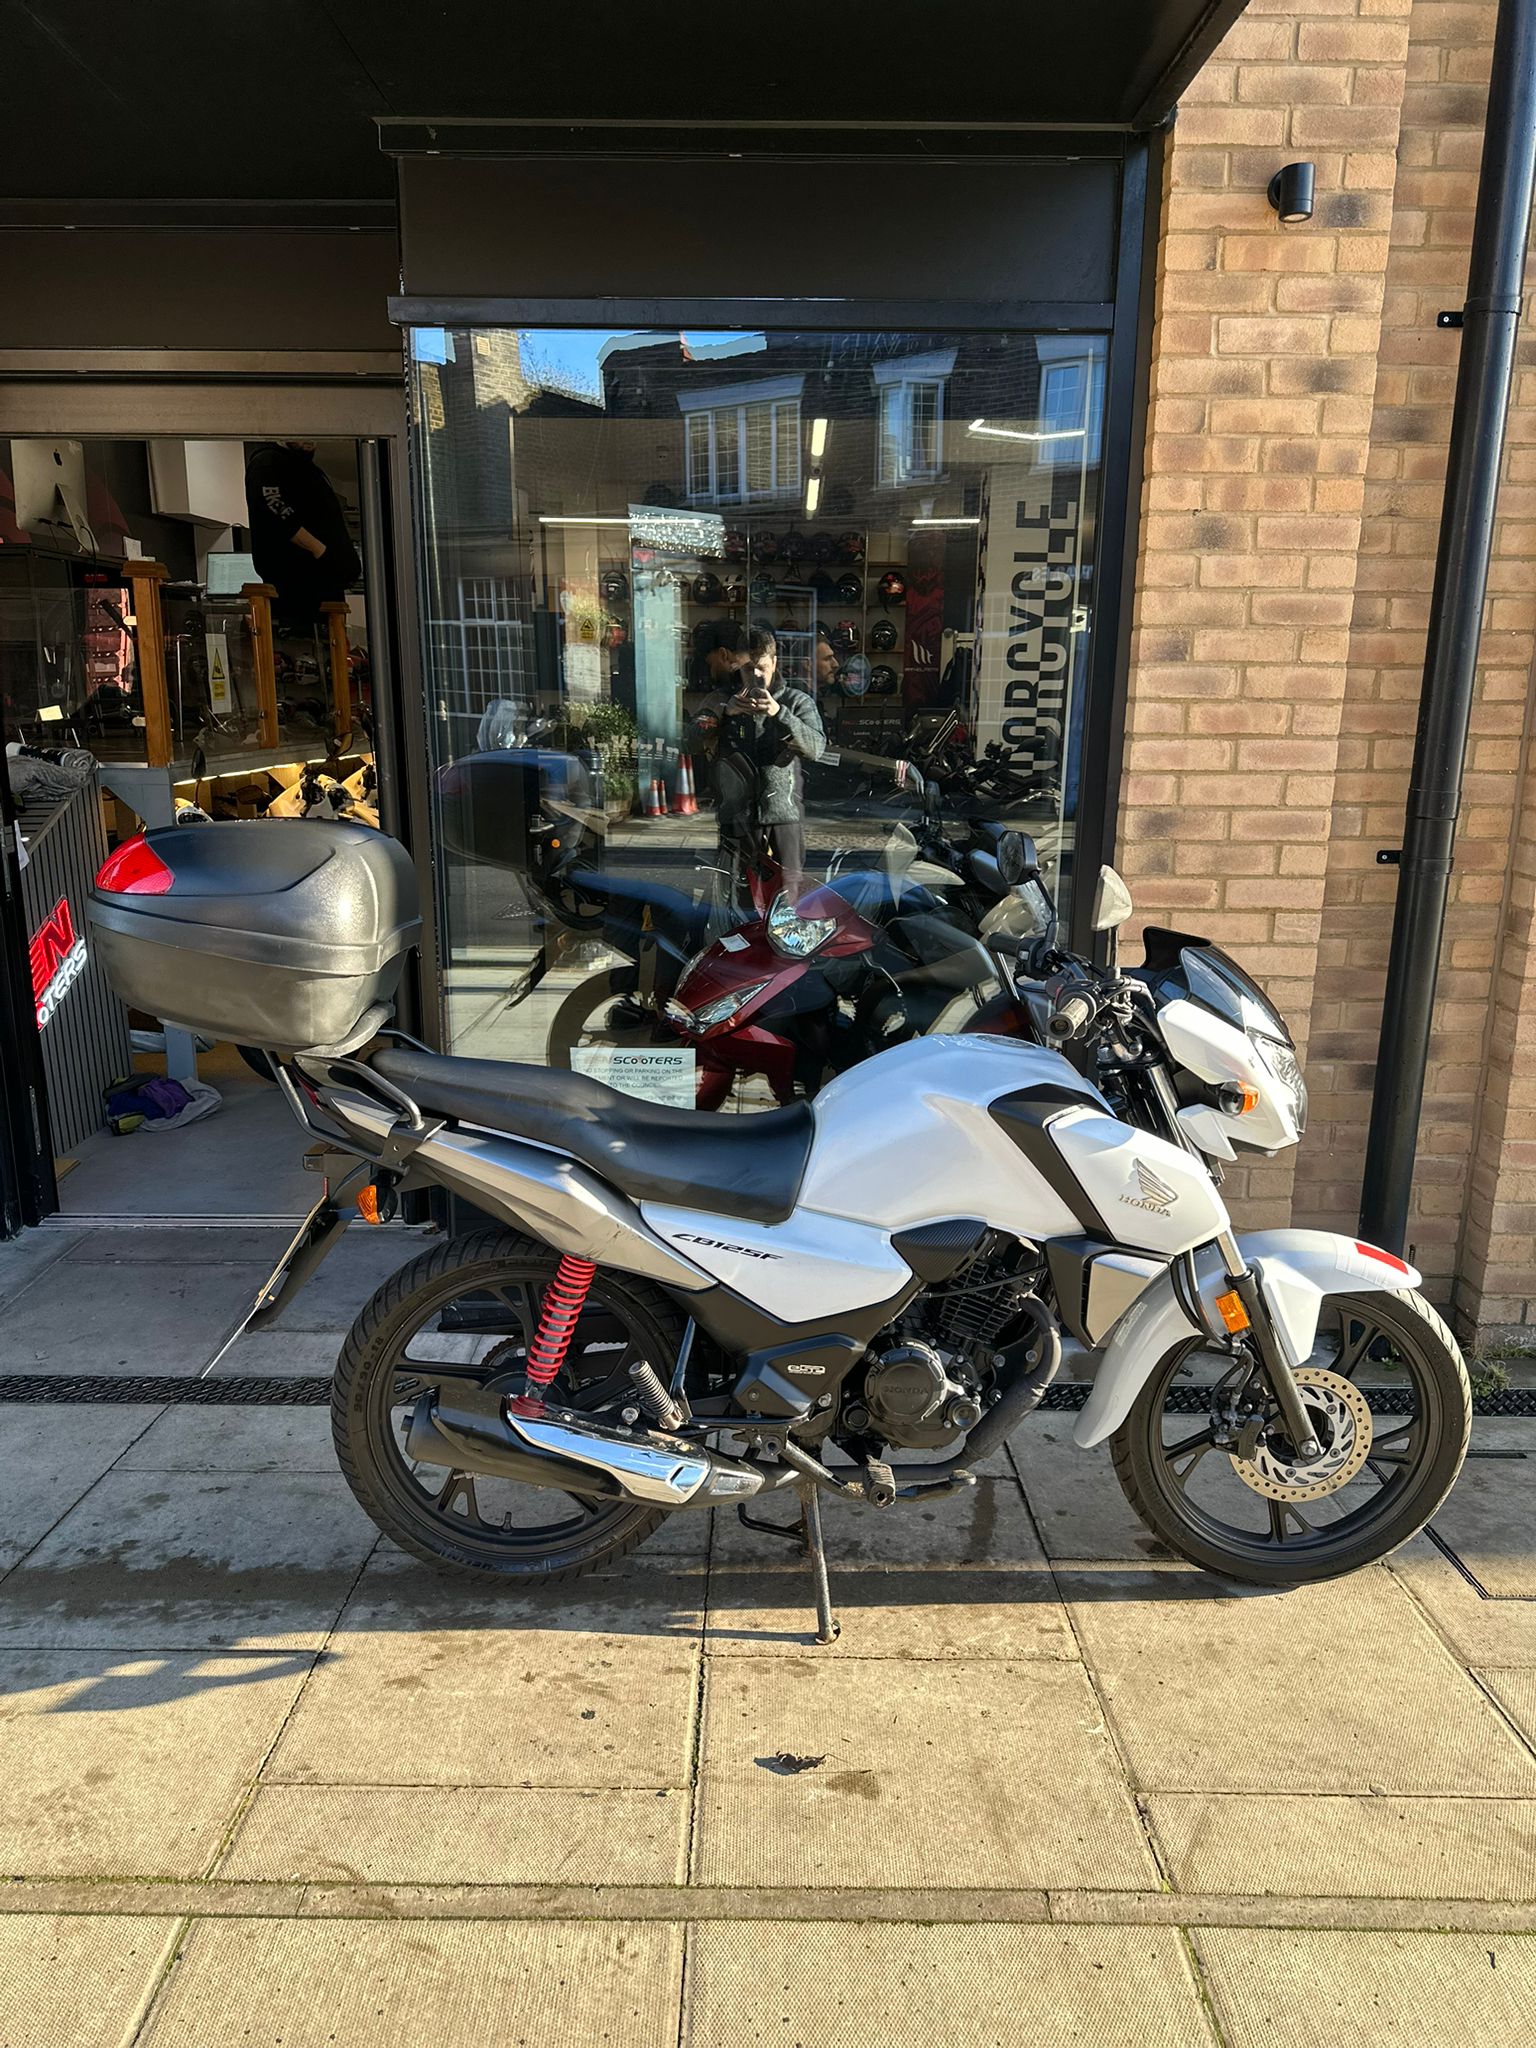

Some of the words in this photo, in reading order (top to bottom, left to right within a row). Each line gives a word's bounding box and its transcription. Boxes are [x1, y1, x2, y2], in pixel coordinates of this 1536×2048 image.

[1119, 1194, 1171, 1217] HONDA
[672, 1233, 784, 1260] CB125F
[883, 1385, 929, 1395] HONDA
